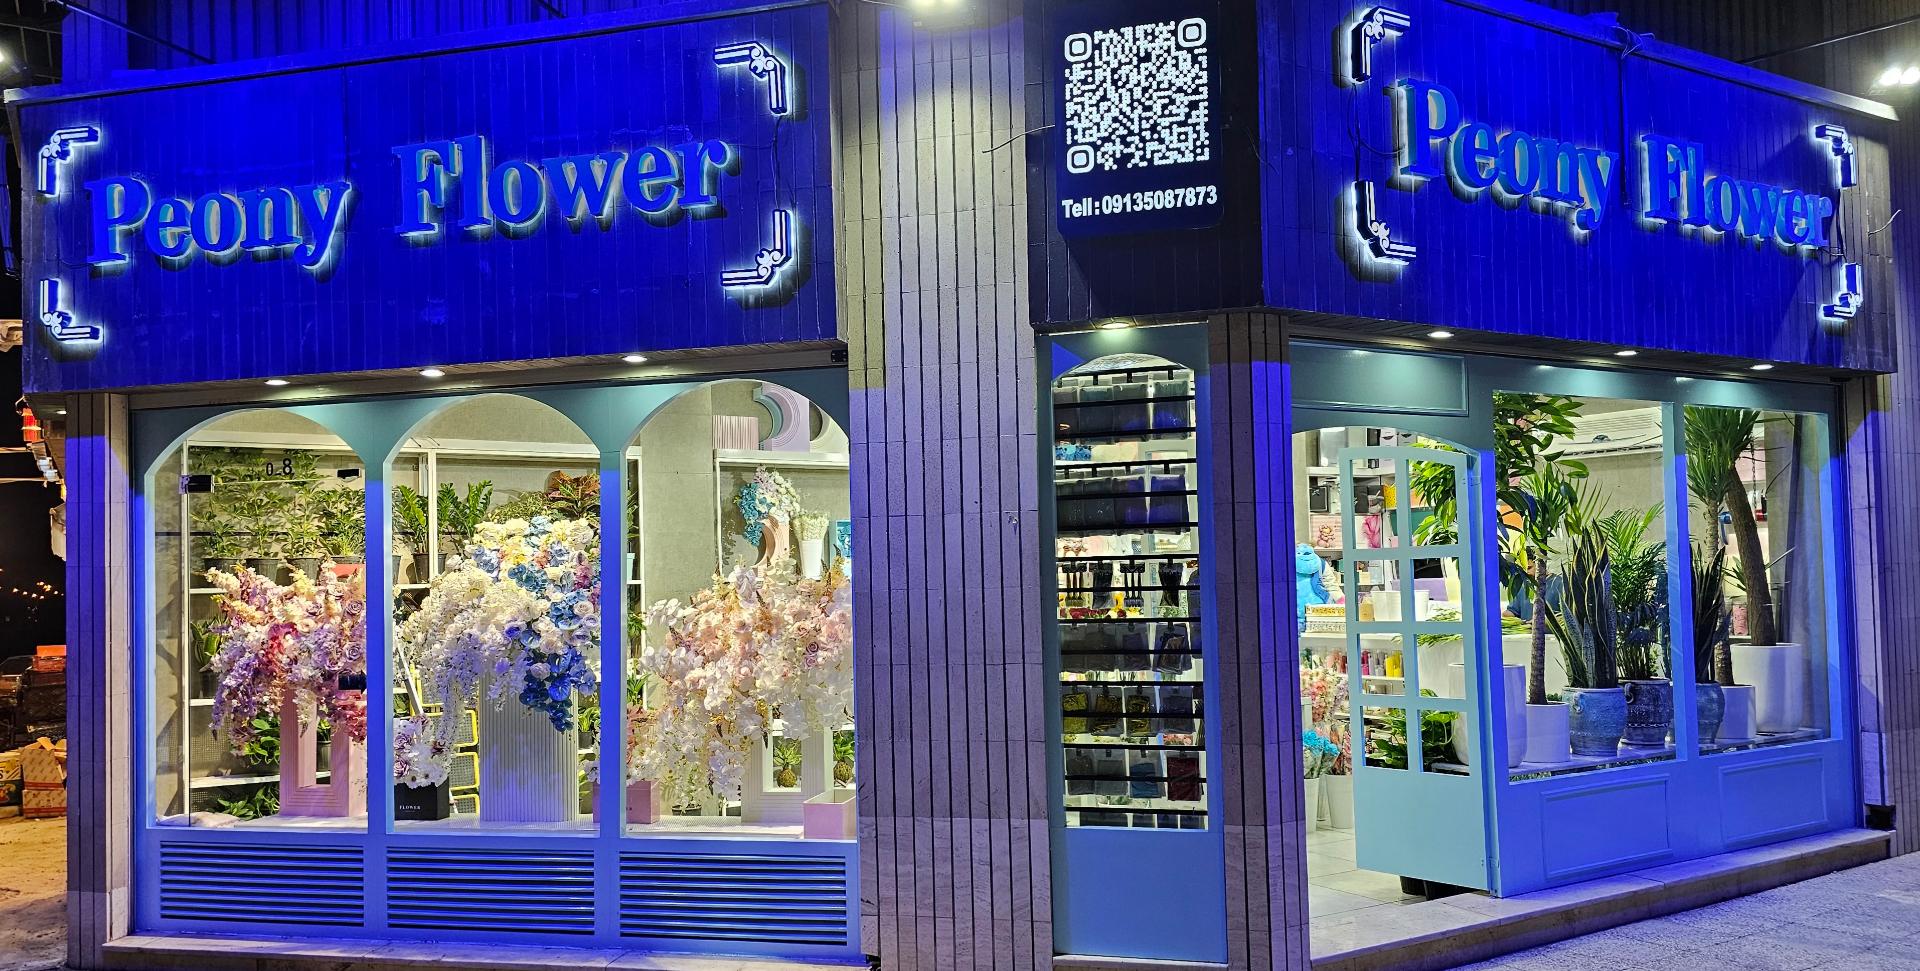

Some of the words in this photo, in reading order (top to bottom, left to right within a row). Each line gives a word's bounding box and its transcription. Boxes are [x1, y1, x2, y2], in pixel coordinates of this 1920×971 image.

[84, 175, 352, 270] Peony
[391, 134, 732, 237] Flower
[1396, 77, 1619, 233] Peony
[1641, 133, 1833, 249] Flower
